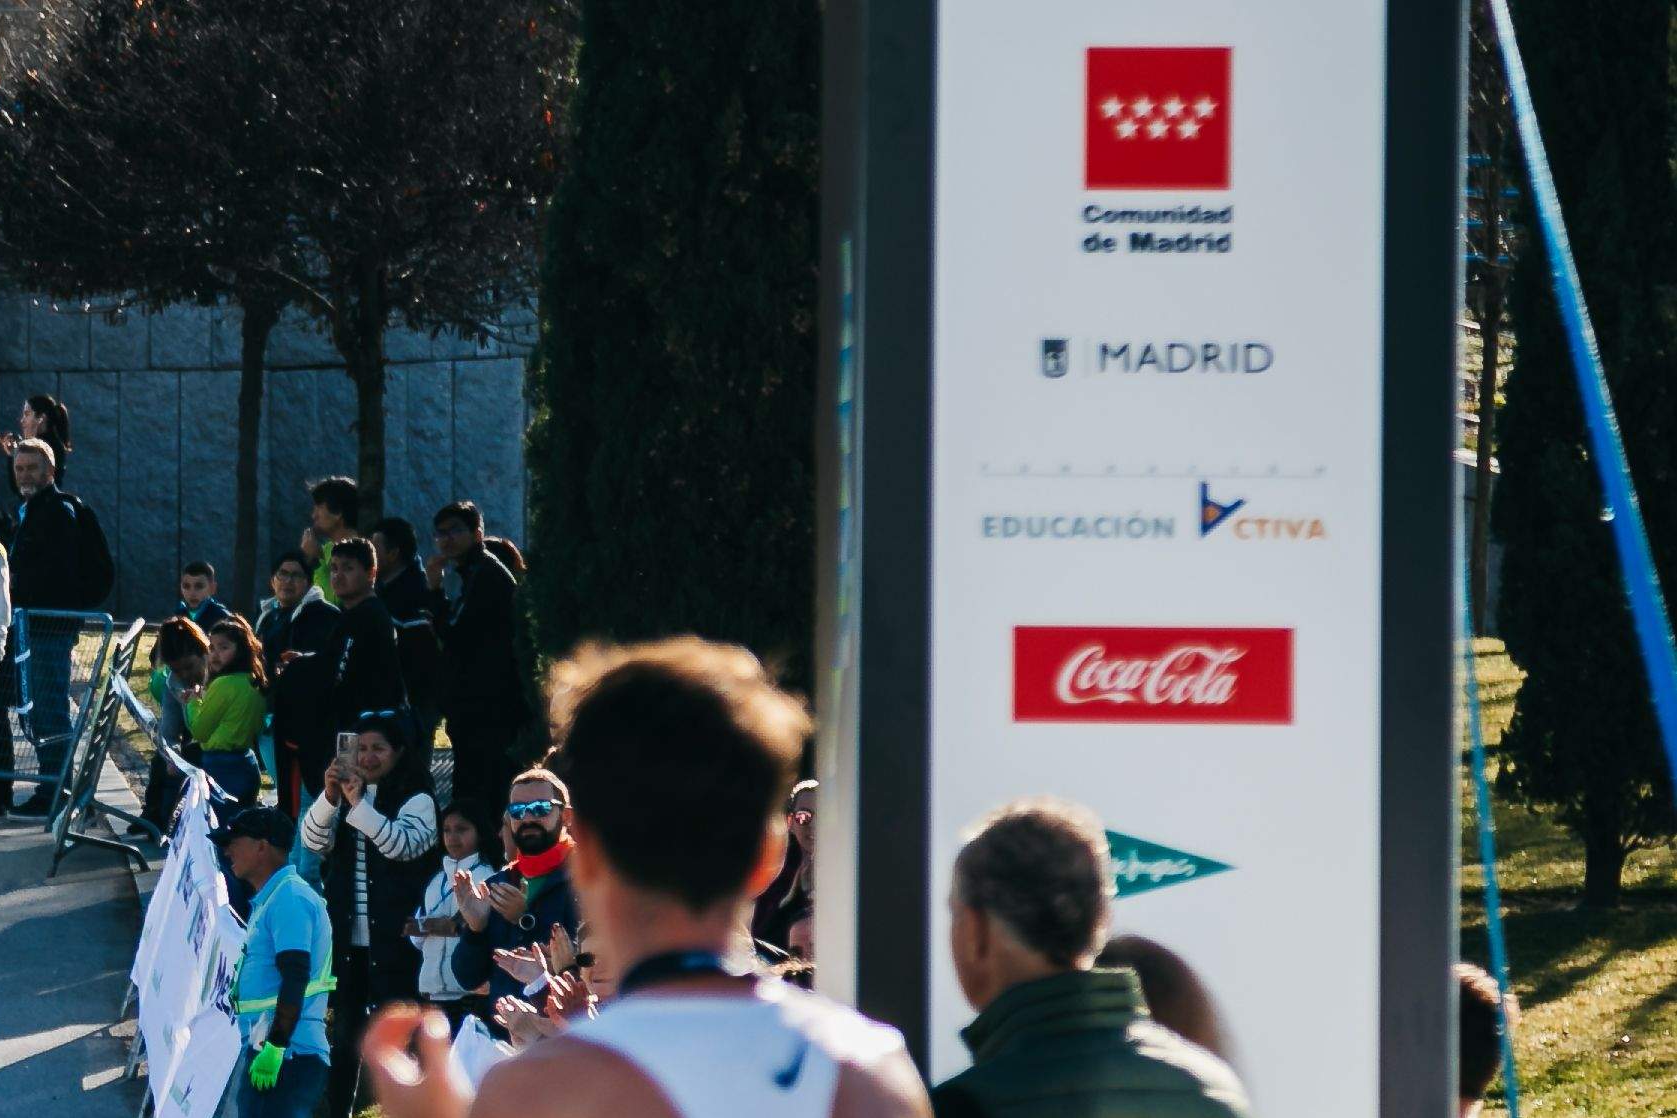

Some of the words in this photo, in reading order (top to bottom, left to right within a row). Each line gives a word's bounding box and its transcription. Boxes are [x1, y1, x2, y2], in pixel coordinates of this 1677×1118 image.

[1083, 204, 1233, 223] Comunidad
[1083, 232, 1117, 253] de
[1129, 232, 1231, 253] Madrid
[1099, 342, 1274, 374] MADRID
[982, 510, 1174, 539] EDUCACIÓN
